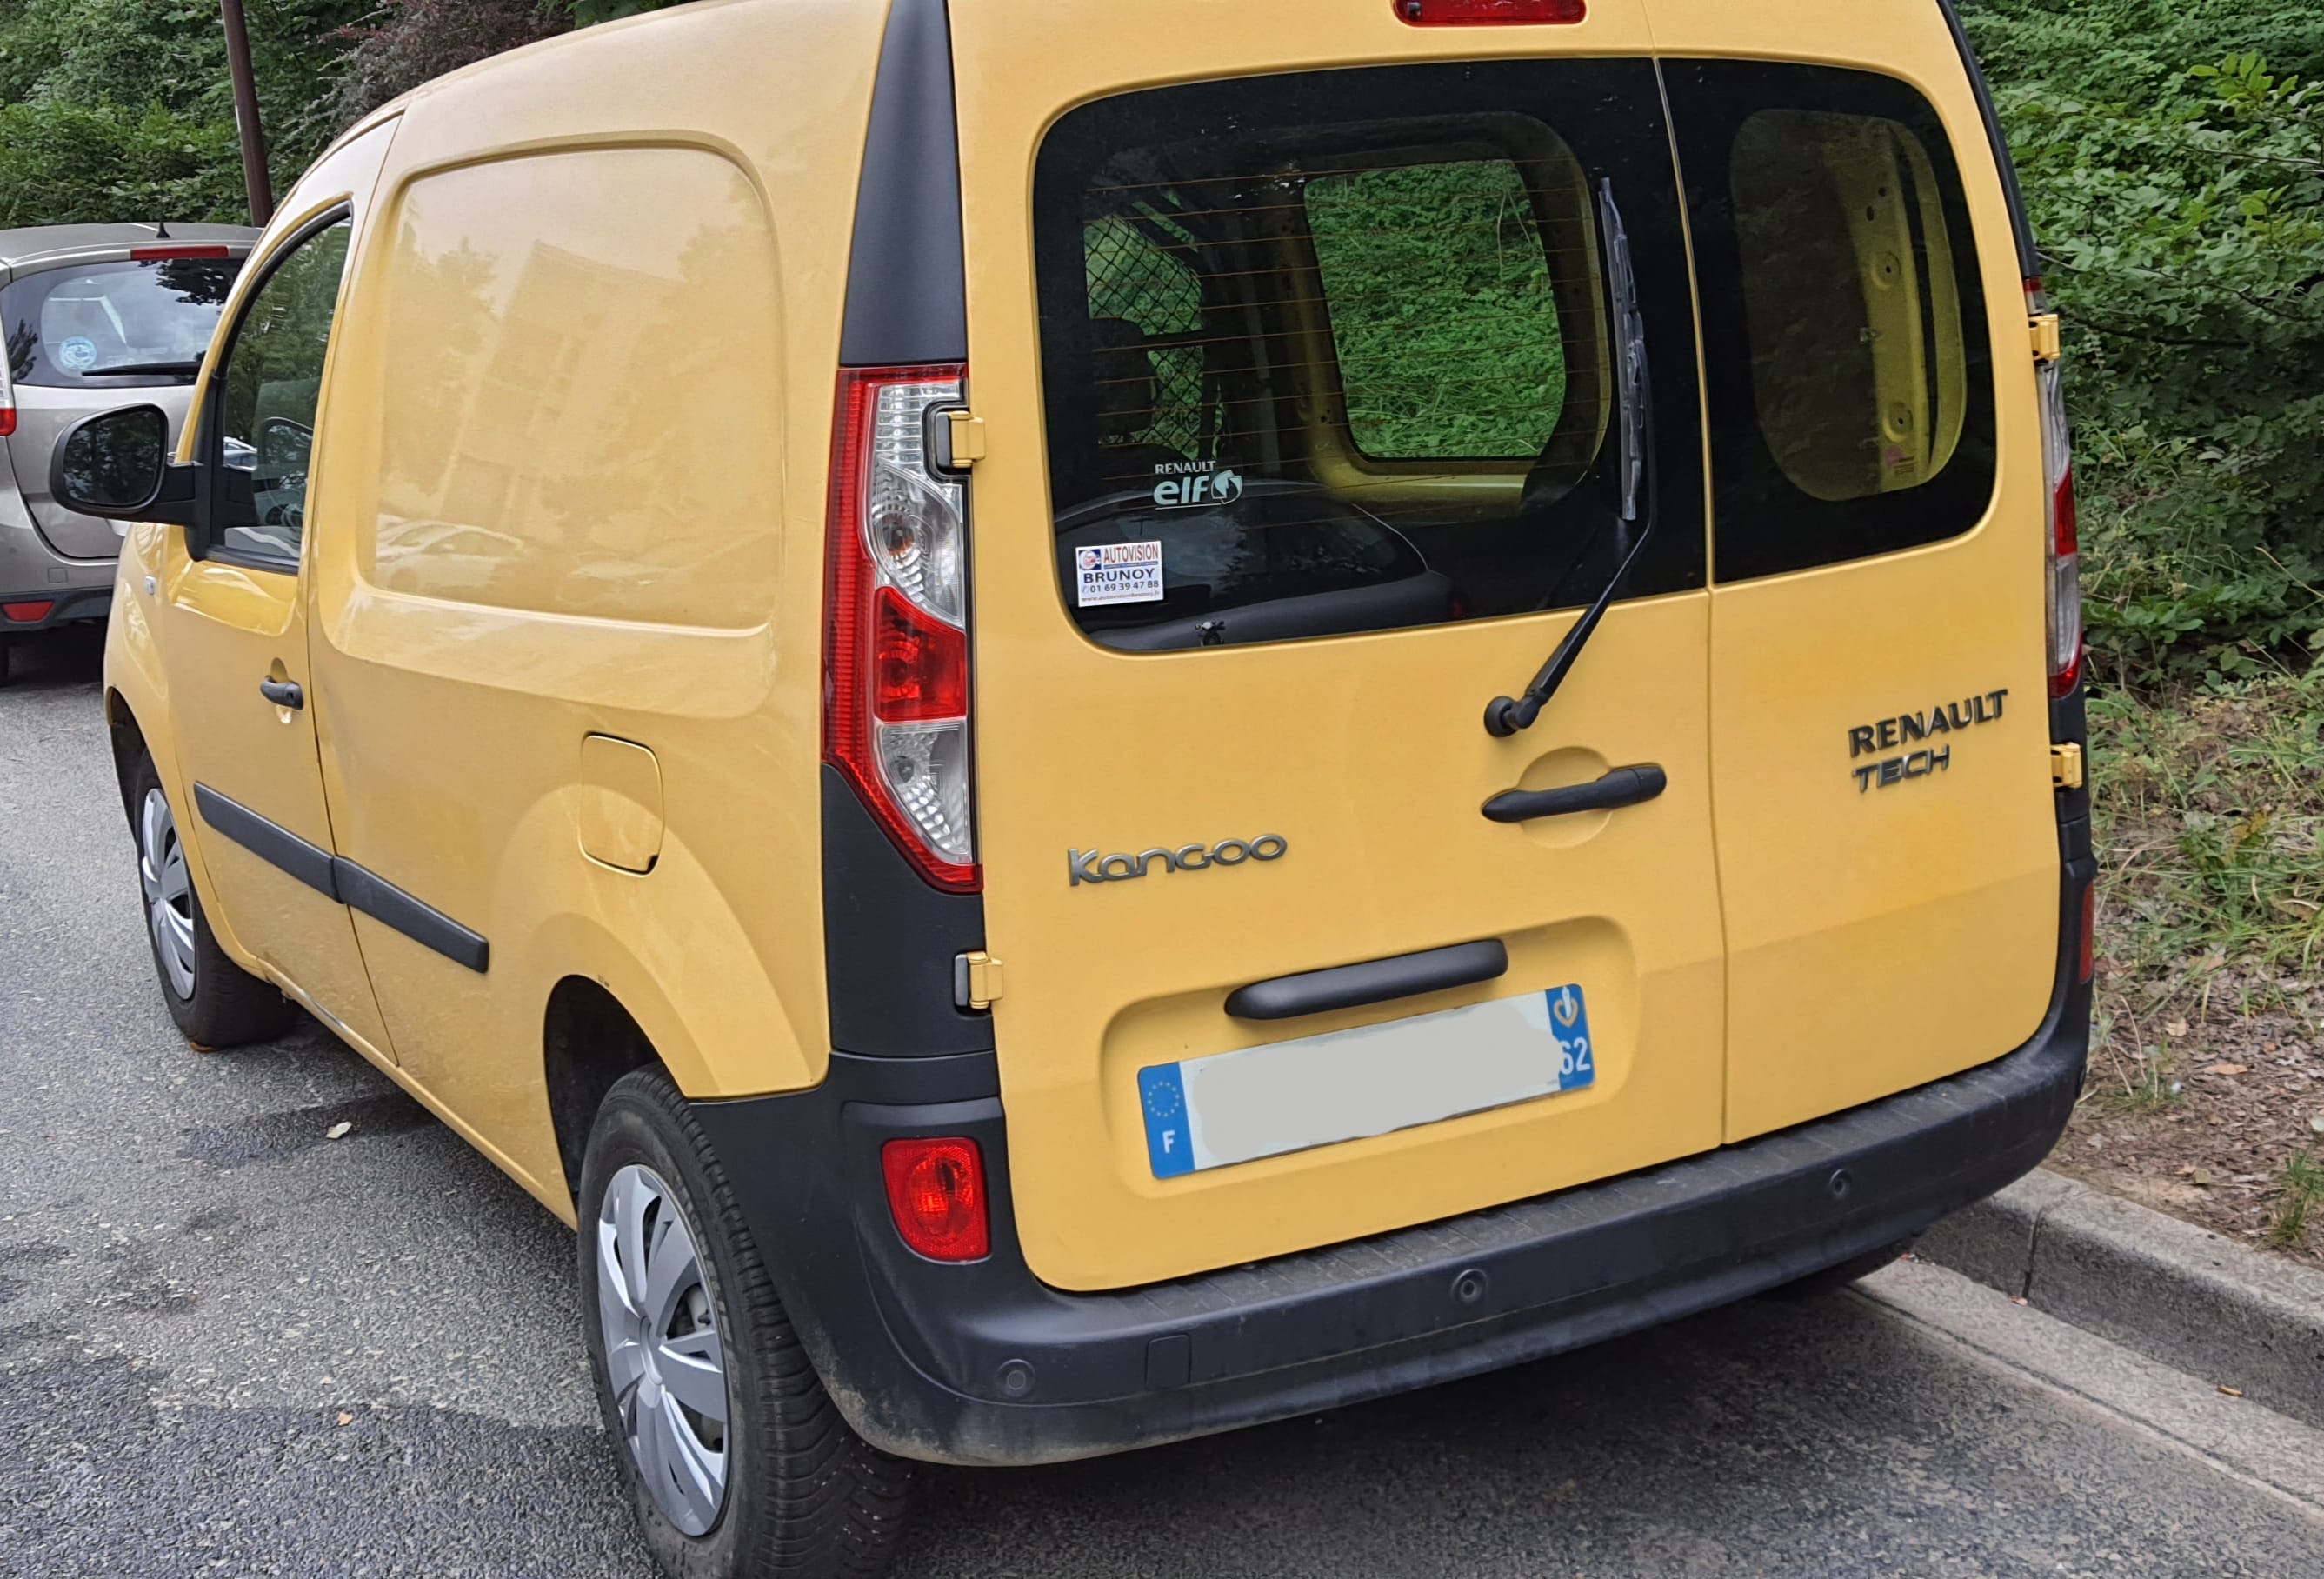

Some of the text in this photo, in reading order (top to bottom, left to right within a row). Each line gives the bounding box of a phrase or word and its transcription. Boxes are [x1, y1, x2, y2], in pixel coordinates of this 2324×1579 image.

[1155, 460, 1216, 475] RENAULT
[1153, 475, 1209, 505] elf
[1103, 543, 1159, 563] AUTOVISION
[1083, 568, 1155, 583] BRUNOY
[1089, 579, 1159, 593] 01 69 39 47 88
[1848, 688, 2008, 759] RENAULT
[1850, 743, 1951, 795] TECH
[1067, 833, 1288, 888] Kangoo
[1162, 1129, 1175, 1154] F
